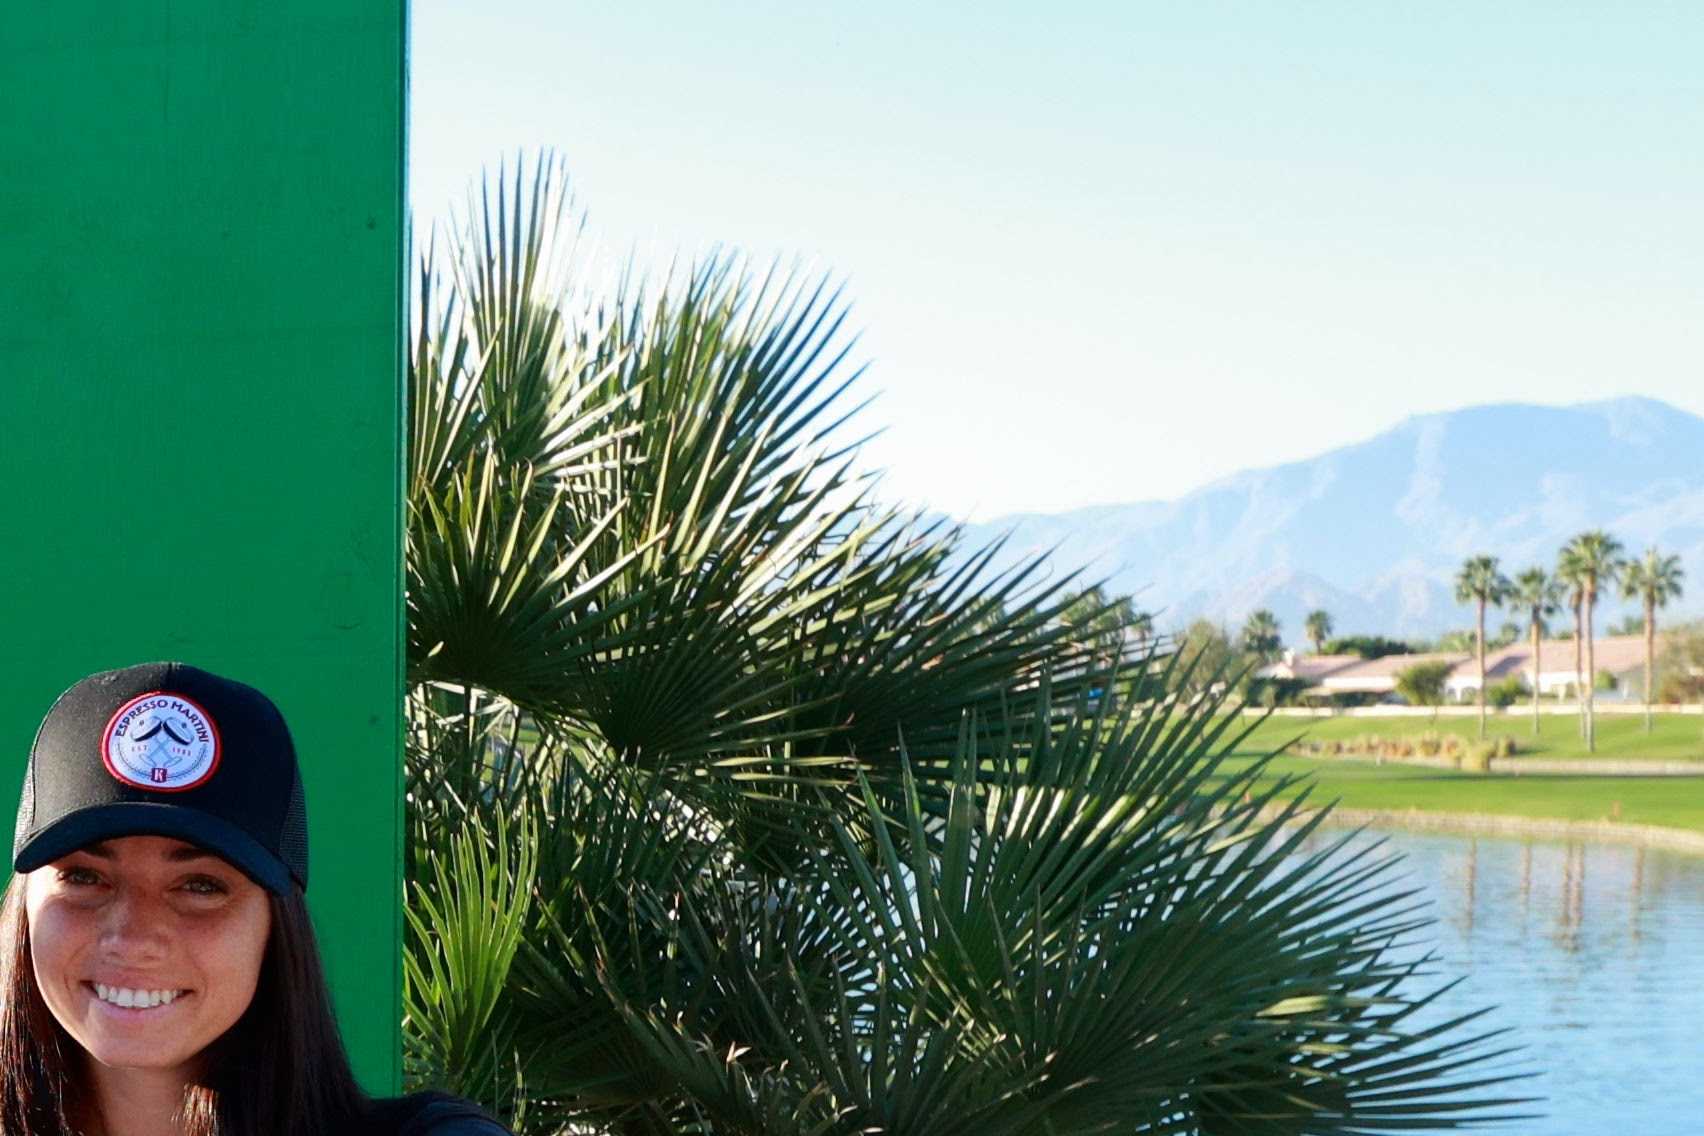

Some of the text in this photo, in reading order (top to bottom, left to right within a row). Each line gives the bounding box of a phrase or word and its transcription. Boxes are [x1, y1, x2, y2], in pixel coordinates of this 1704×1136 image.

[115, 699, 210, 743] ESPRESSO MARTINI
[154, 768, 164, 782] K
